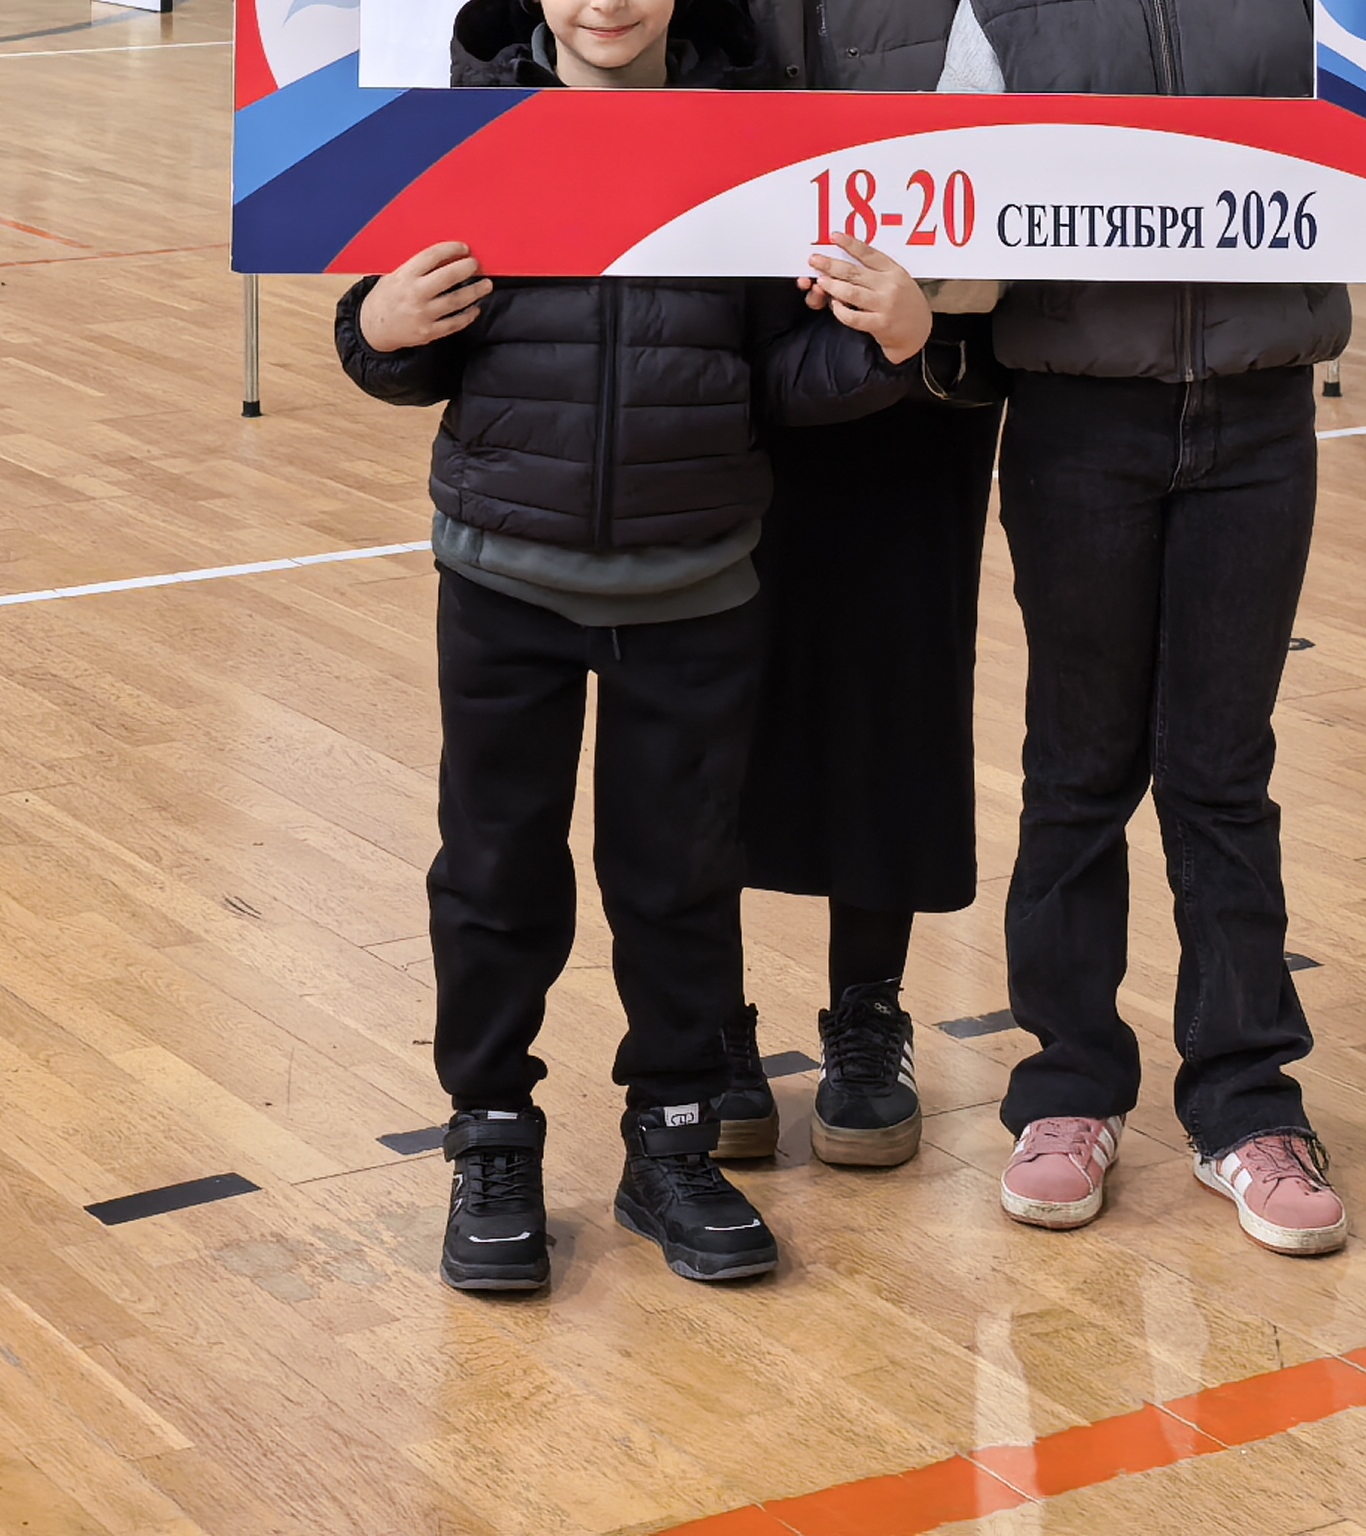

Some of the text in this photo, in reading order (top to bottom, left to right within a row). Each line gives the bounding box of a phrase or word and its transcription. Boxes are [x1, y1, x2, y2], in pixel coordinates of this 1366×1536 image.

[809, 168, 1318, 250] 18-20 СЕНТЯБРЯ 2026
